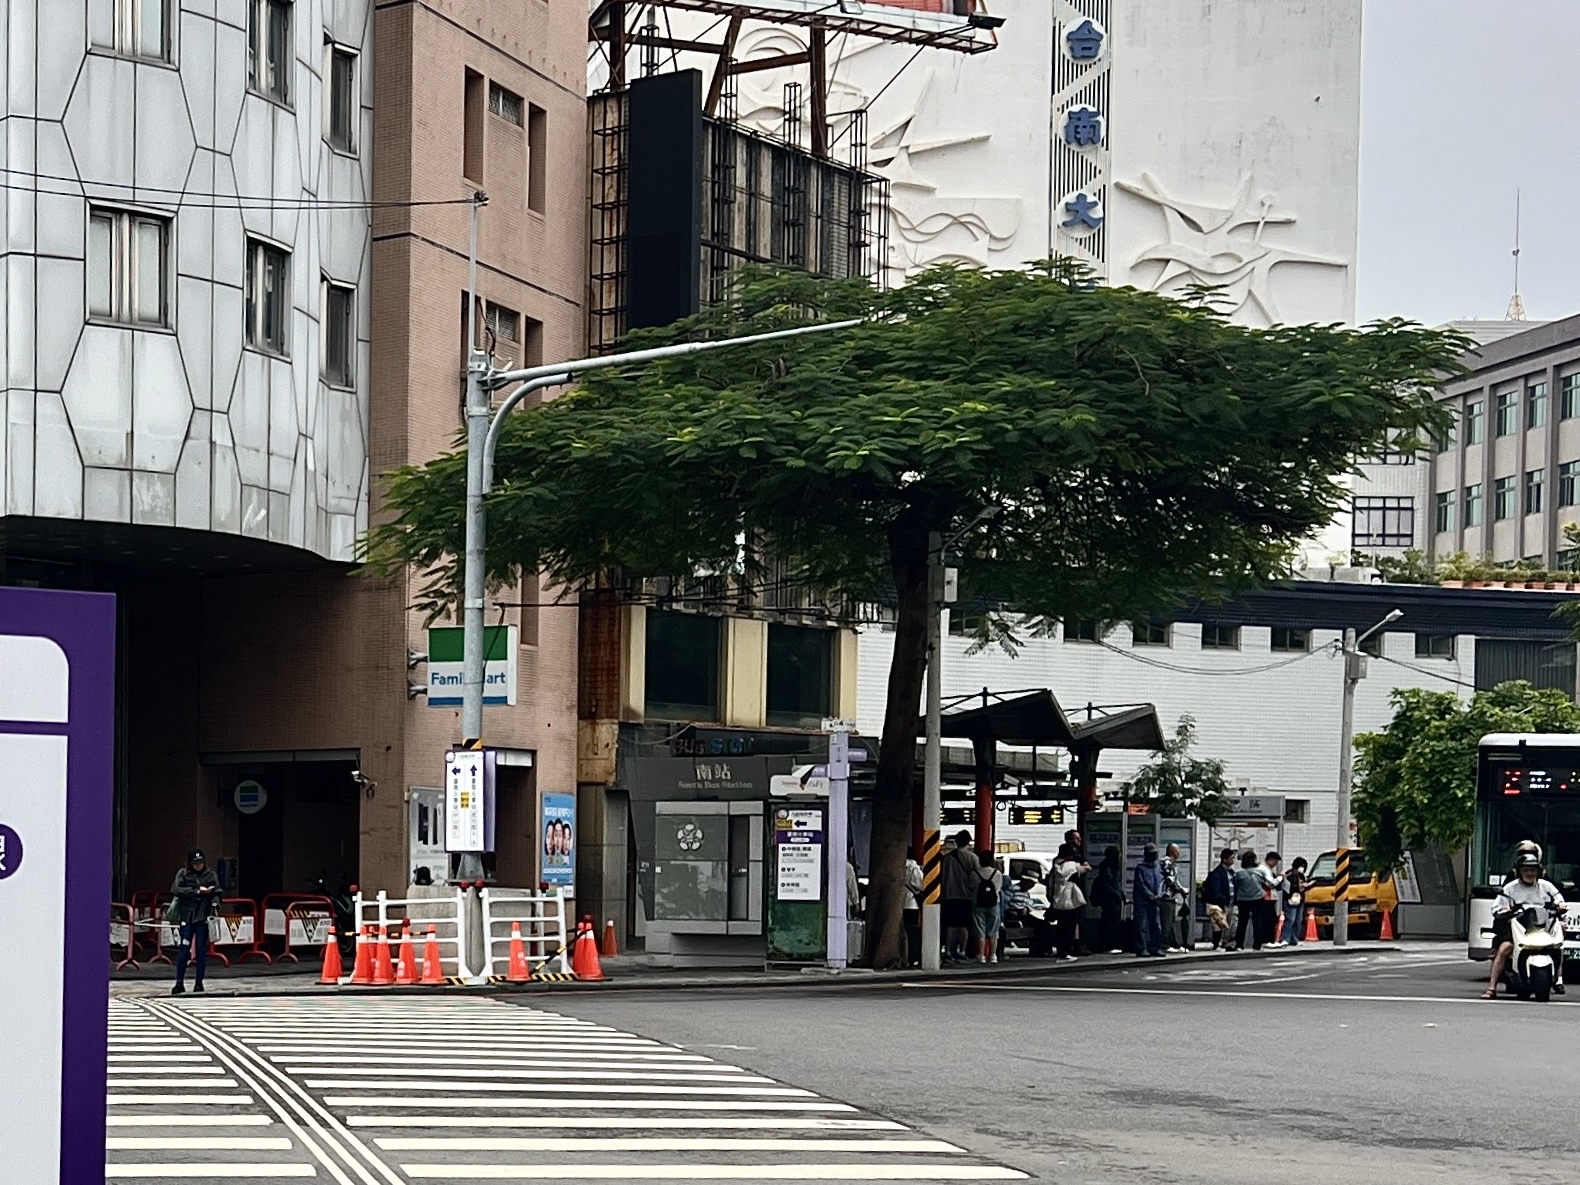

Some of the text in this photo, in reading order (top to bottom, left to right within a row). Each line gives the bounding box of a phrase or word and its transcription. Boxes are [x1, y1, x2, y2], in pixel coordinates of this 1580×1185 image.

[431, 672, 506, 685] Famiart
[695, 763, 732, 780] 南站
[721, 780, 753, 789] Station
